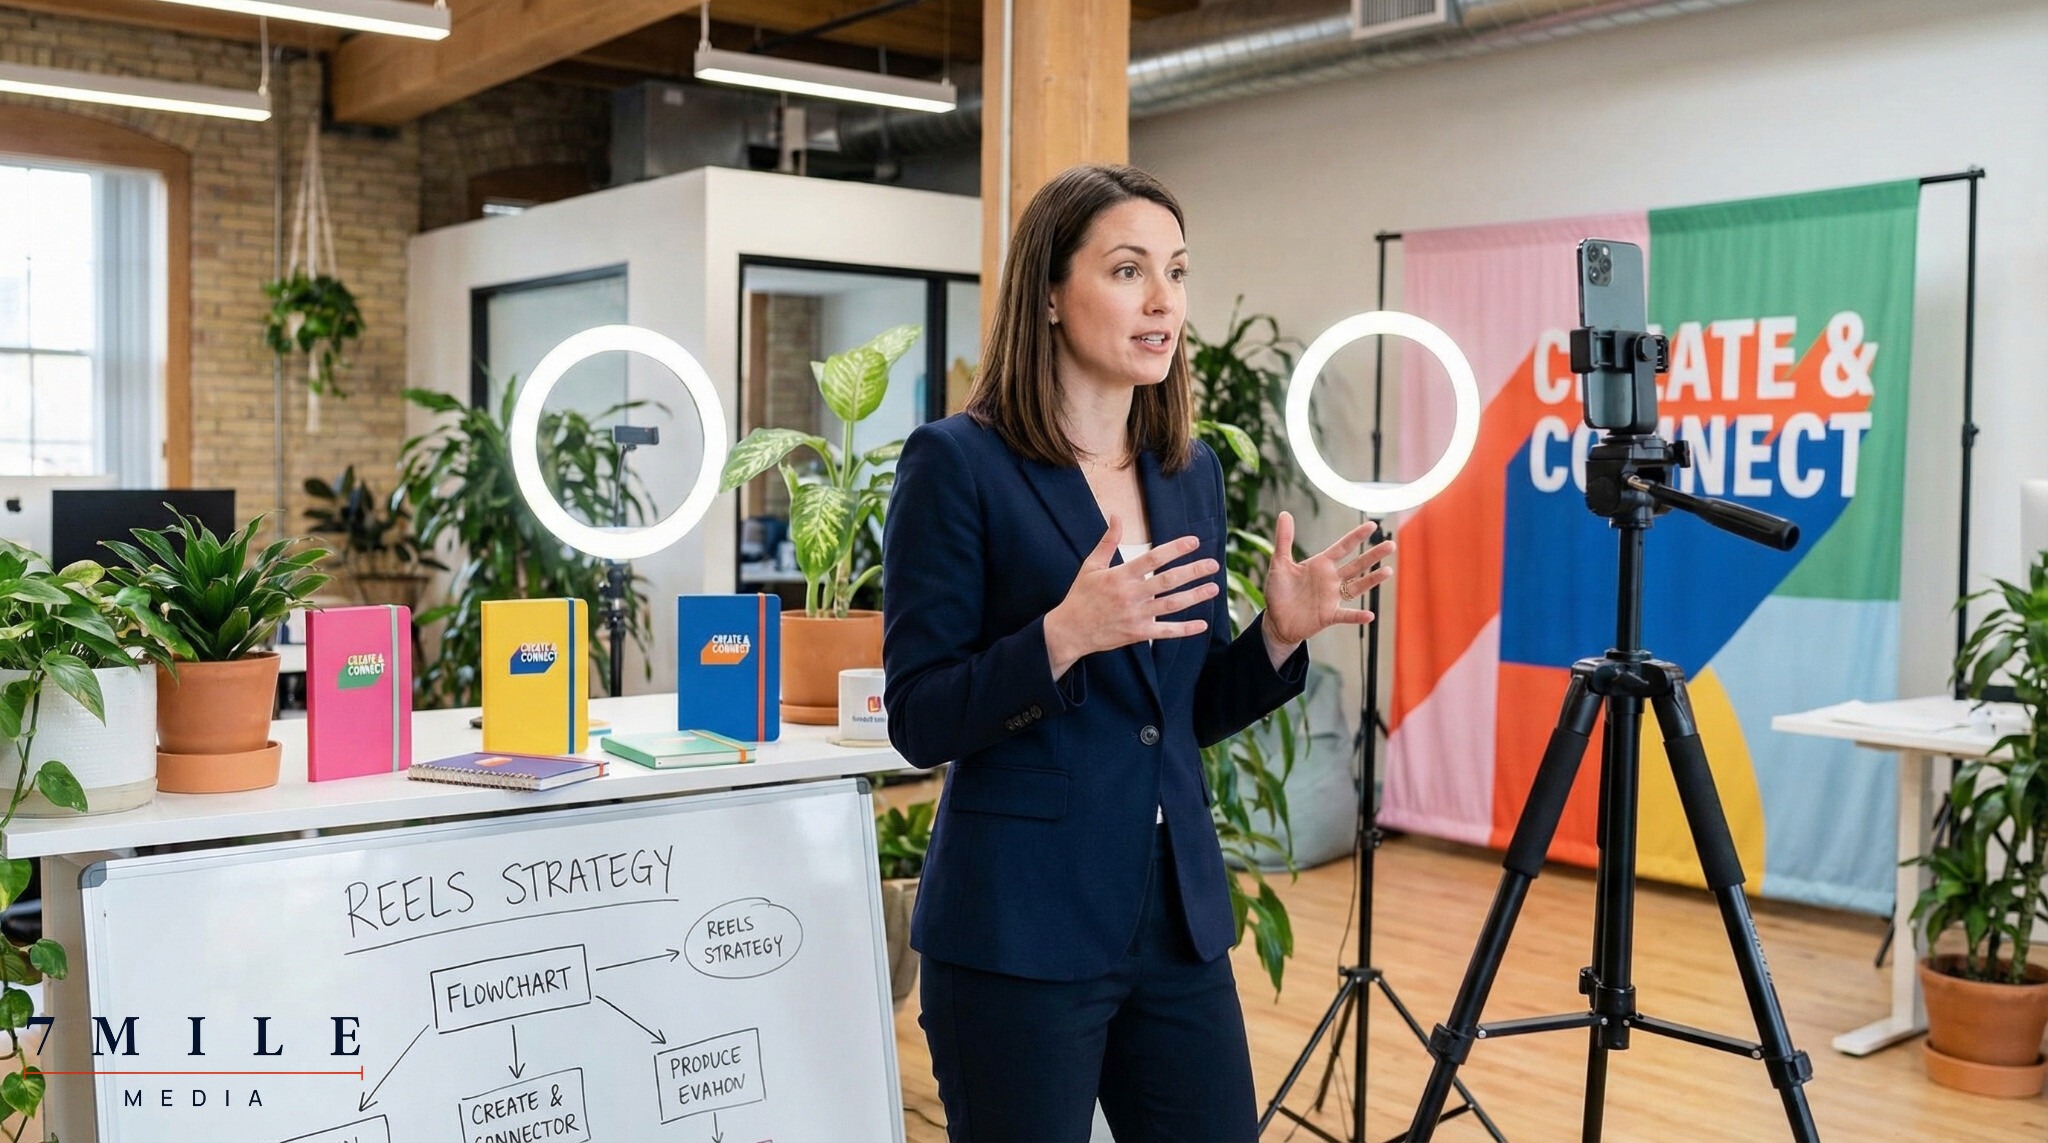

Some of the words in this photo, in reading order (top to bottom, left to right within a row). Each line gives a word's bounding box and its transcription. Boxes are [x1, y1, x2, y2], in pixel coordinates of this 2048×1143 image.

[1533, 317, 1796, 405] CATE
[1820, 311, 1879, 398] &
[1529, 412, 1872, 498] CNECT
[344, 871, 474, 938] REELS
[502, 845, 674, 904] STRATEGY
[704, 934, 783, 964] STRATEGY
[707, 916, 754, 939] REELS
[447, 966, 572, 1013] FLOWCHART
[670, 1046, 742, 1079] PRODUCE
[471, 1090, 539, 1125] CREATE
[550, 1084, 563, 1107] &
